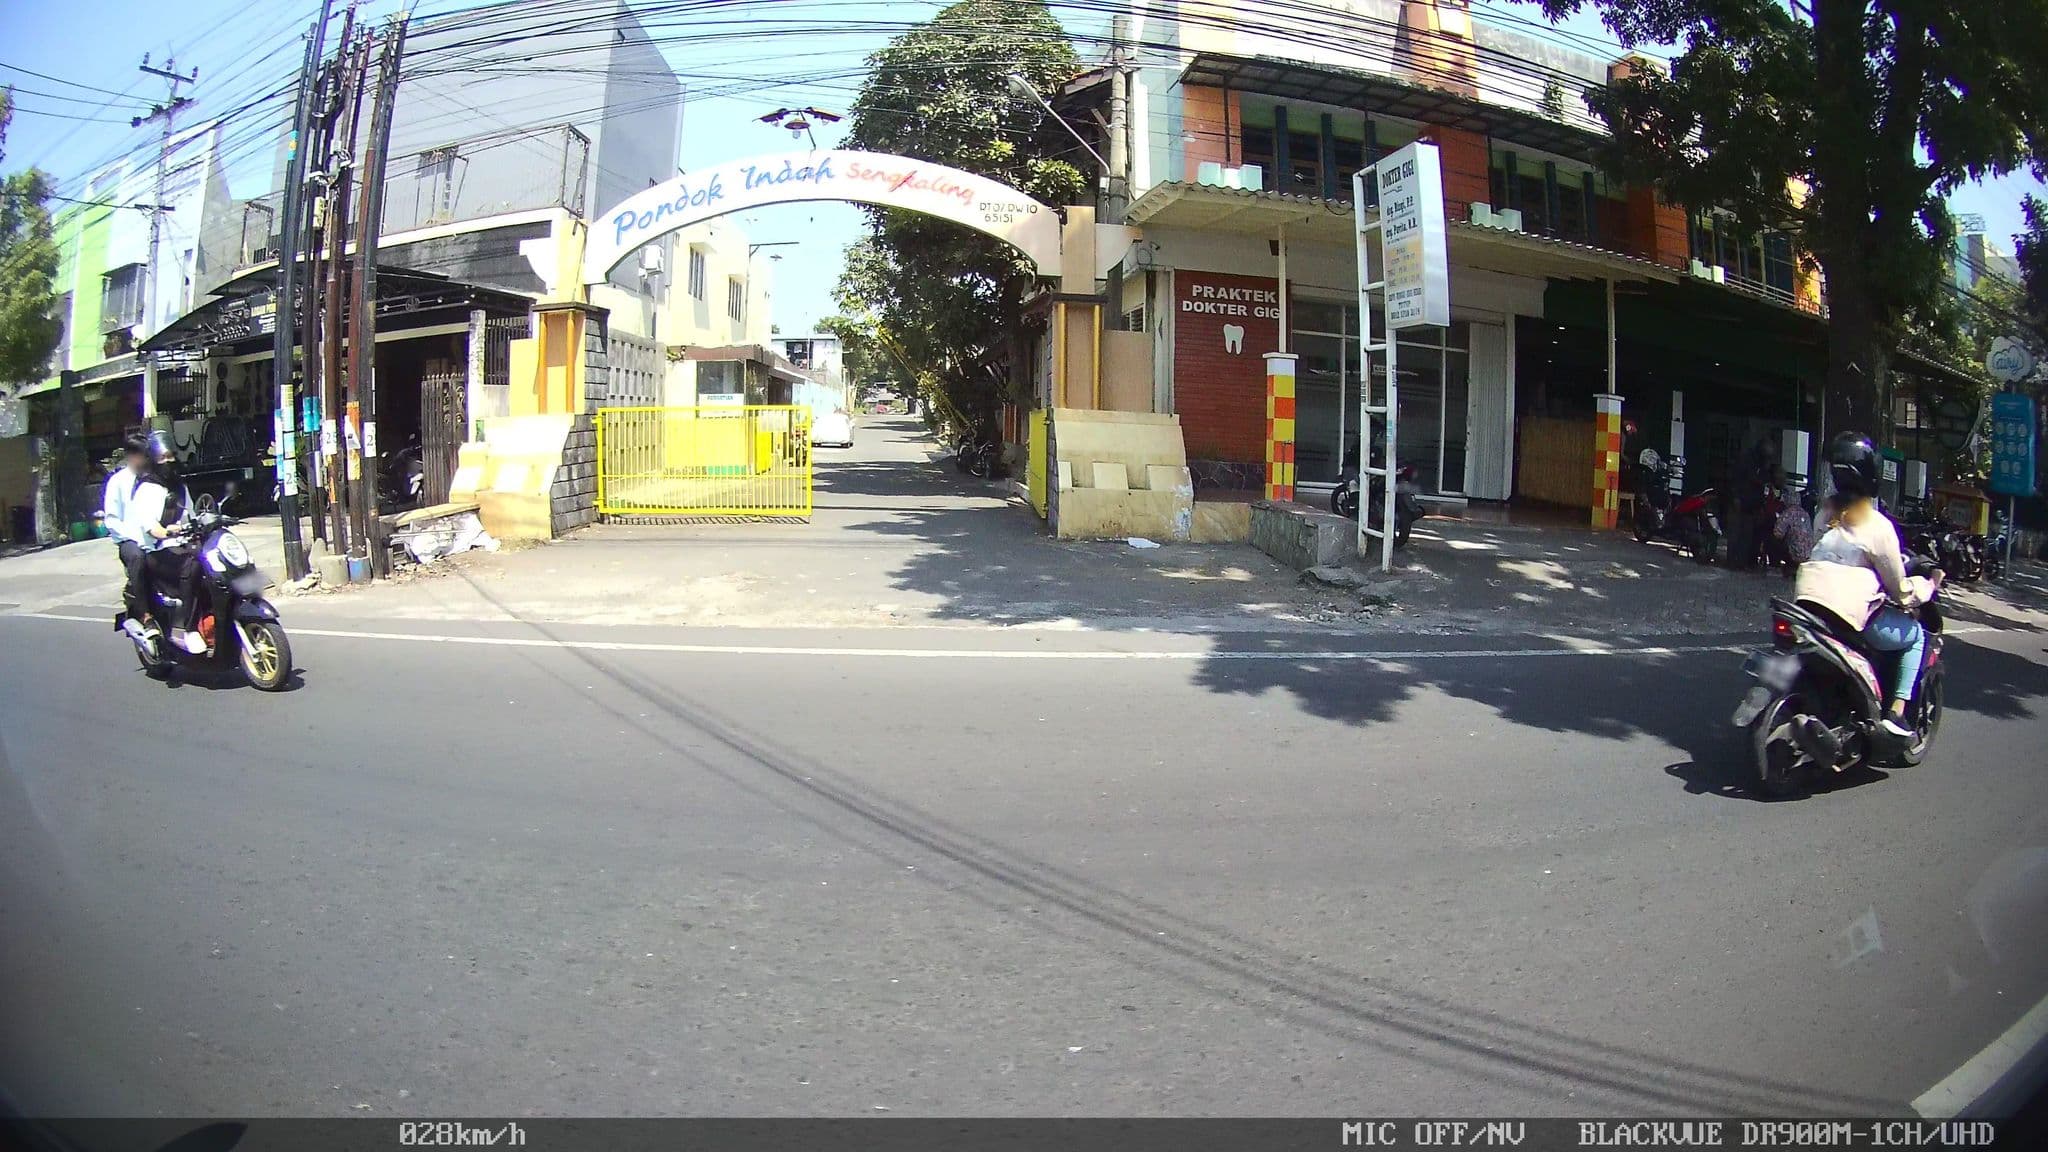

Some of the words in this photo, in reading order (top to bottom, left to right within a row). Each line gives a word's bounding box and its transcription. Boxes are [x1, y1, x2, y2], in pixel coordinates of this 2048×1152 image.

[613, 173, 724, 246] Pondok
[740, 157, 835, 191] Indah
[1192, 284, 1277, 303] PRAKTEK
[1182, 300, 1248, 316] DOKTER
[1254, 306, 1280, 319] GIG
